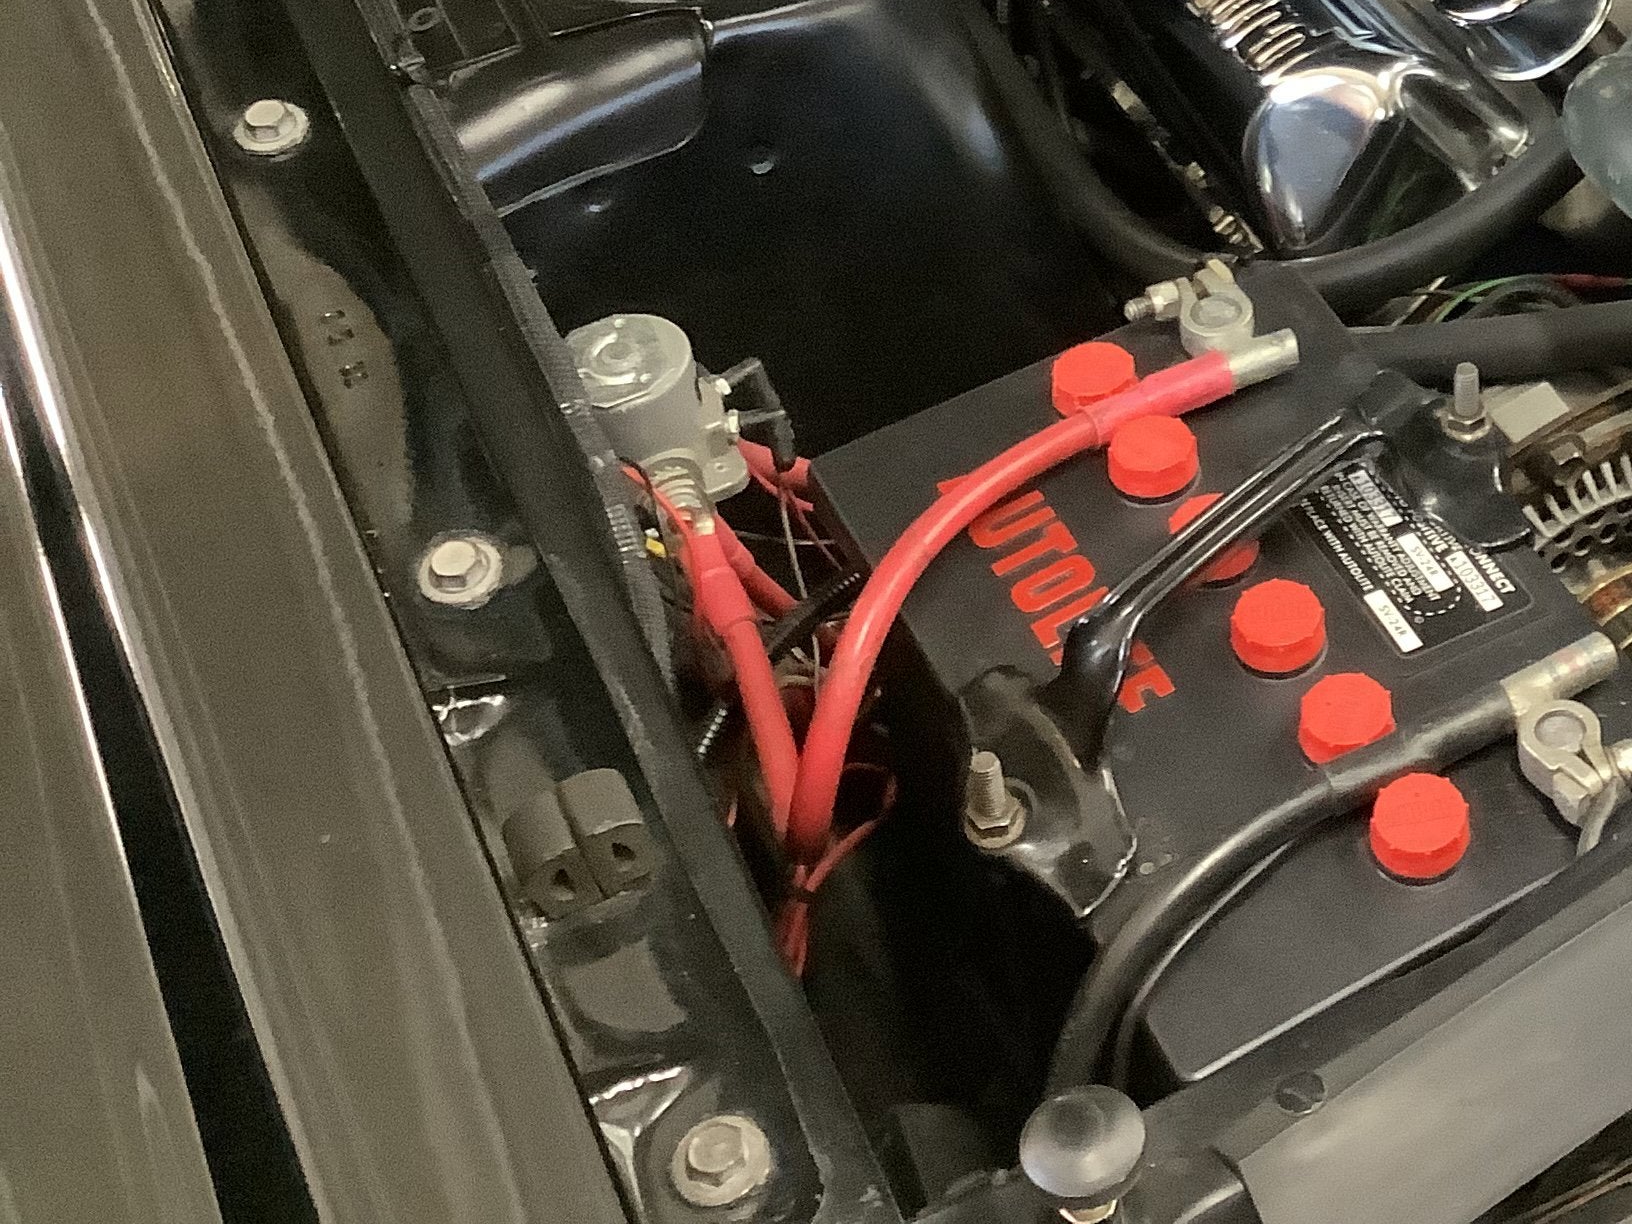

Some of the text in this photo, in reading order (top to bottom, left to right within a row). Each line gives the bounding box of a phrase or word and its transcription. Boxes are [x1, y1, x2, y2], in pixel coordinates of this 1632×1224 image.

[936, 474, 1177, 714] UTOLE
[1323, 528, 1347, 554] WITH
[1338, 551, 1375, 592] AUTOLITE
[1349, 521, 1370, 543] WITH
[1364, 542, 1397, 579] AUTOLITE
[1391, 577, 1415, 603] CLAIM
[1366, 511, 1404, 553] WARRANTY
[1398, 553, 1441, 601] ADJUSTMENT
[1375, 539, 1408, 577] REMOVED
[1403, 576, 1423, 596] AND
